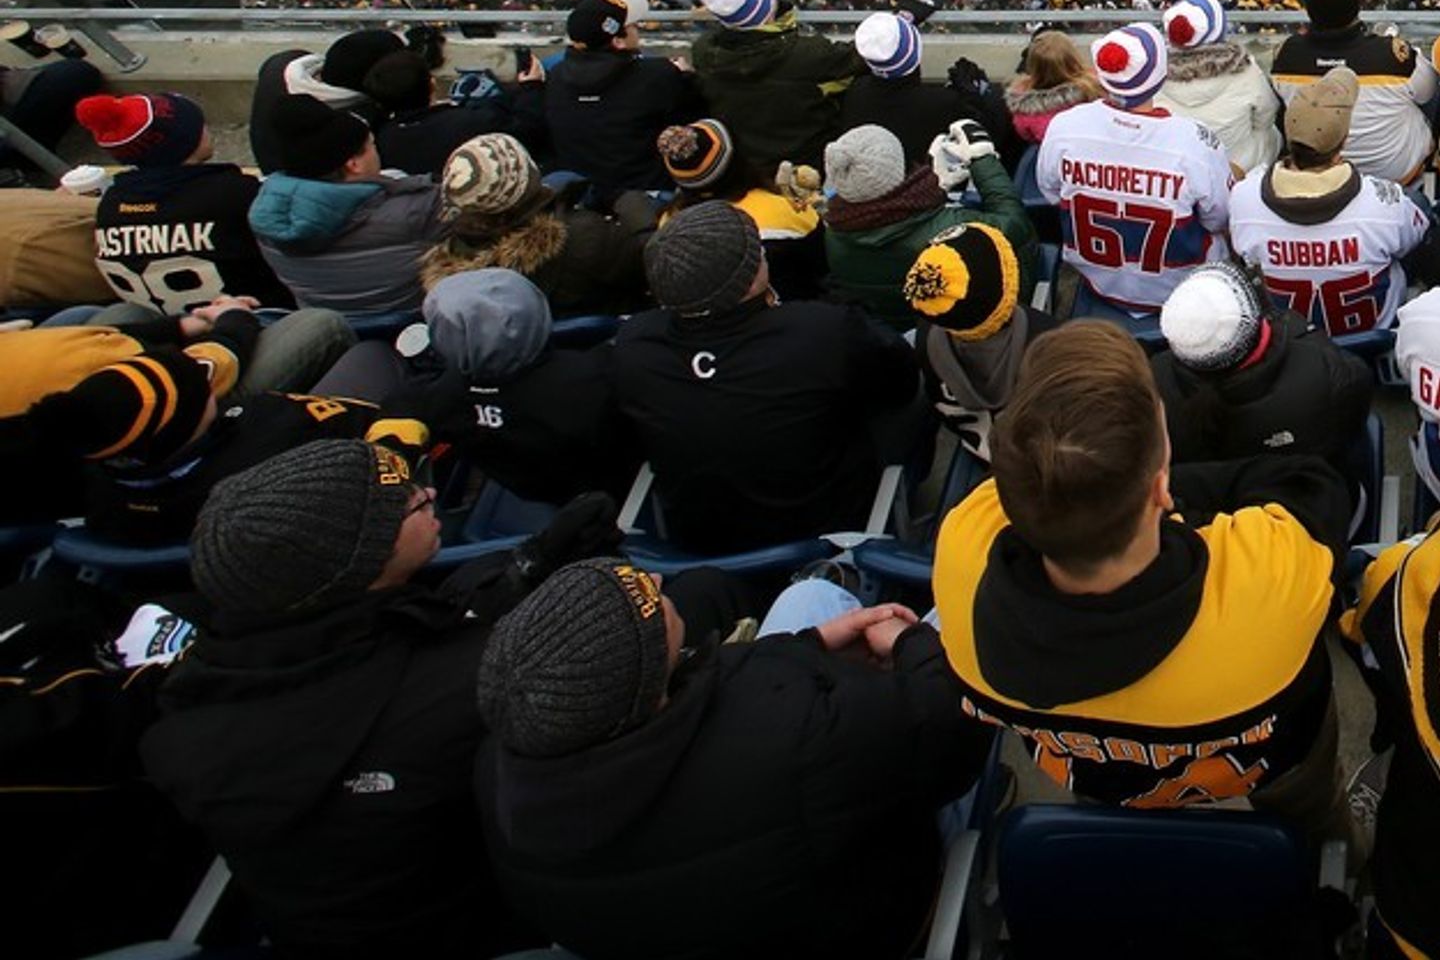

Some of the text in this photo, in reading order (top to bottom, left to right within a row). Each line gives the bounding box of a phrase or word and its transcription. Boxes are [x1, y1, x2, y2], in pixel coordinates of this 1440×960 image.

[1061, 157, 1184, 201] PACIORETTY
[1072, 192, 1175, 275] 67
[1267, 237, 1360, 268] SUBBAN
[1262, 269, 1379, 338] 76
[691, 351, 717, 380] C
[473, 403, 504, 428] 16
